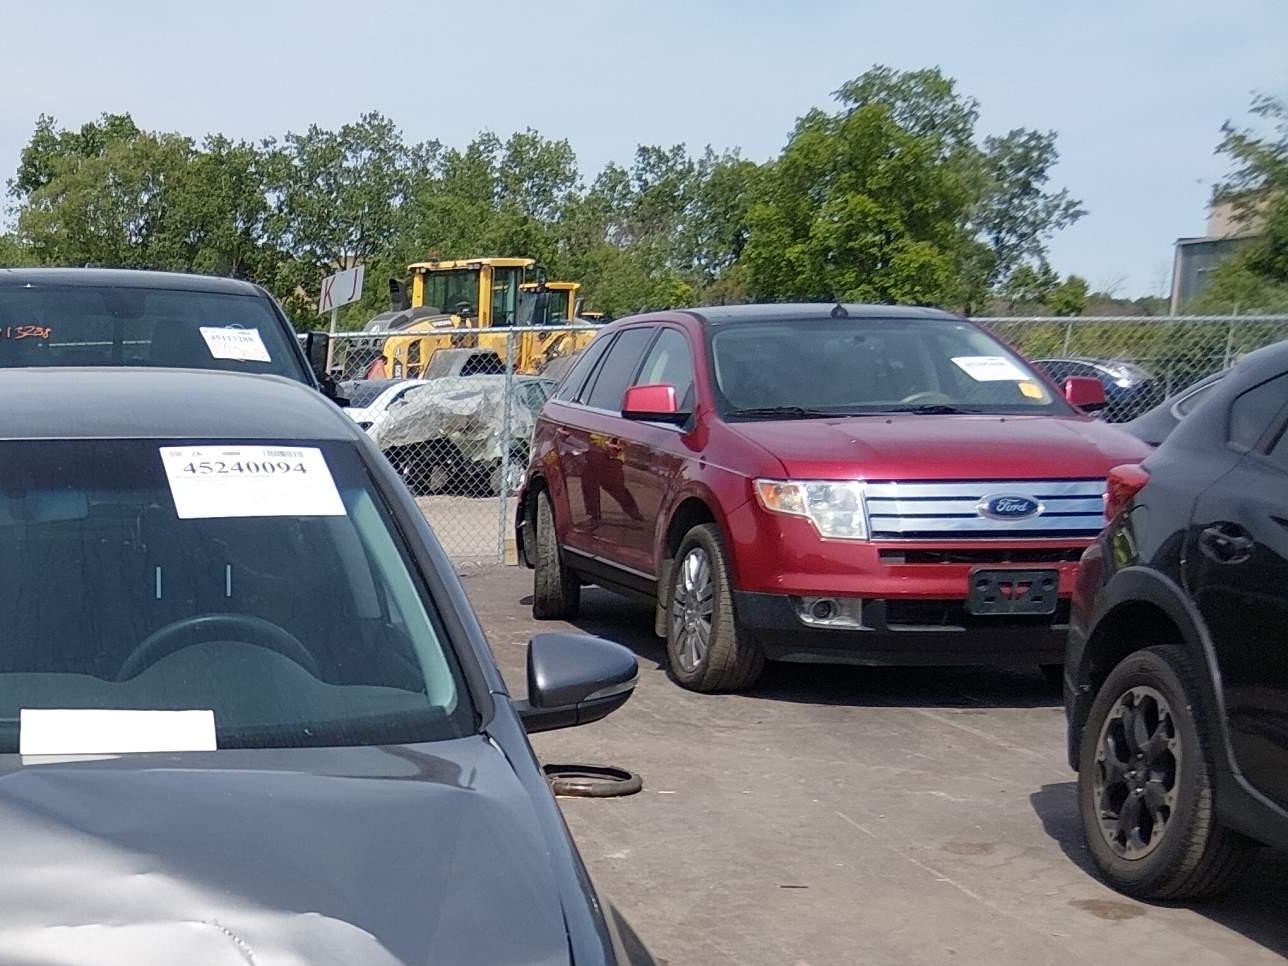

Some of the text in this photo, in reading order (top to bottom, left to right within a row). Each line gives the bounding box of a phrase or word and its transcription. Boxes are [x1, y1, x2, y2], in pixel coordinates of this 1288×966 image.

[323, 276, 336, 311] K
[183, 461, 307, 474] 45240094
[996, 499, 1028, 512] Ford
